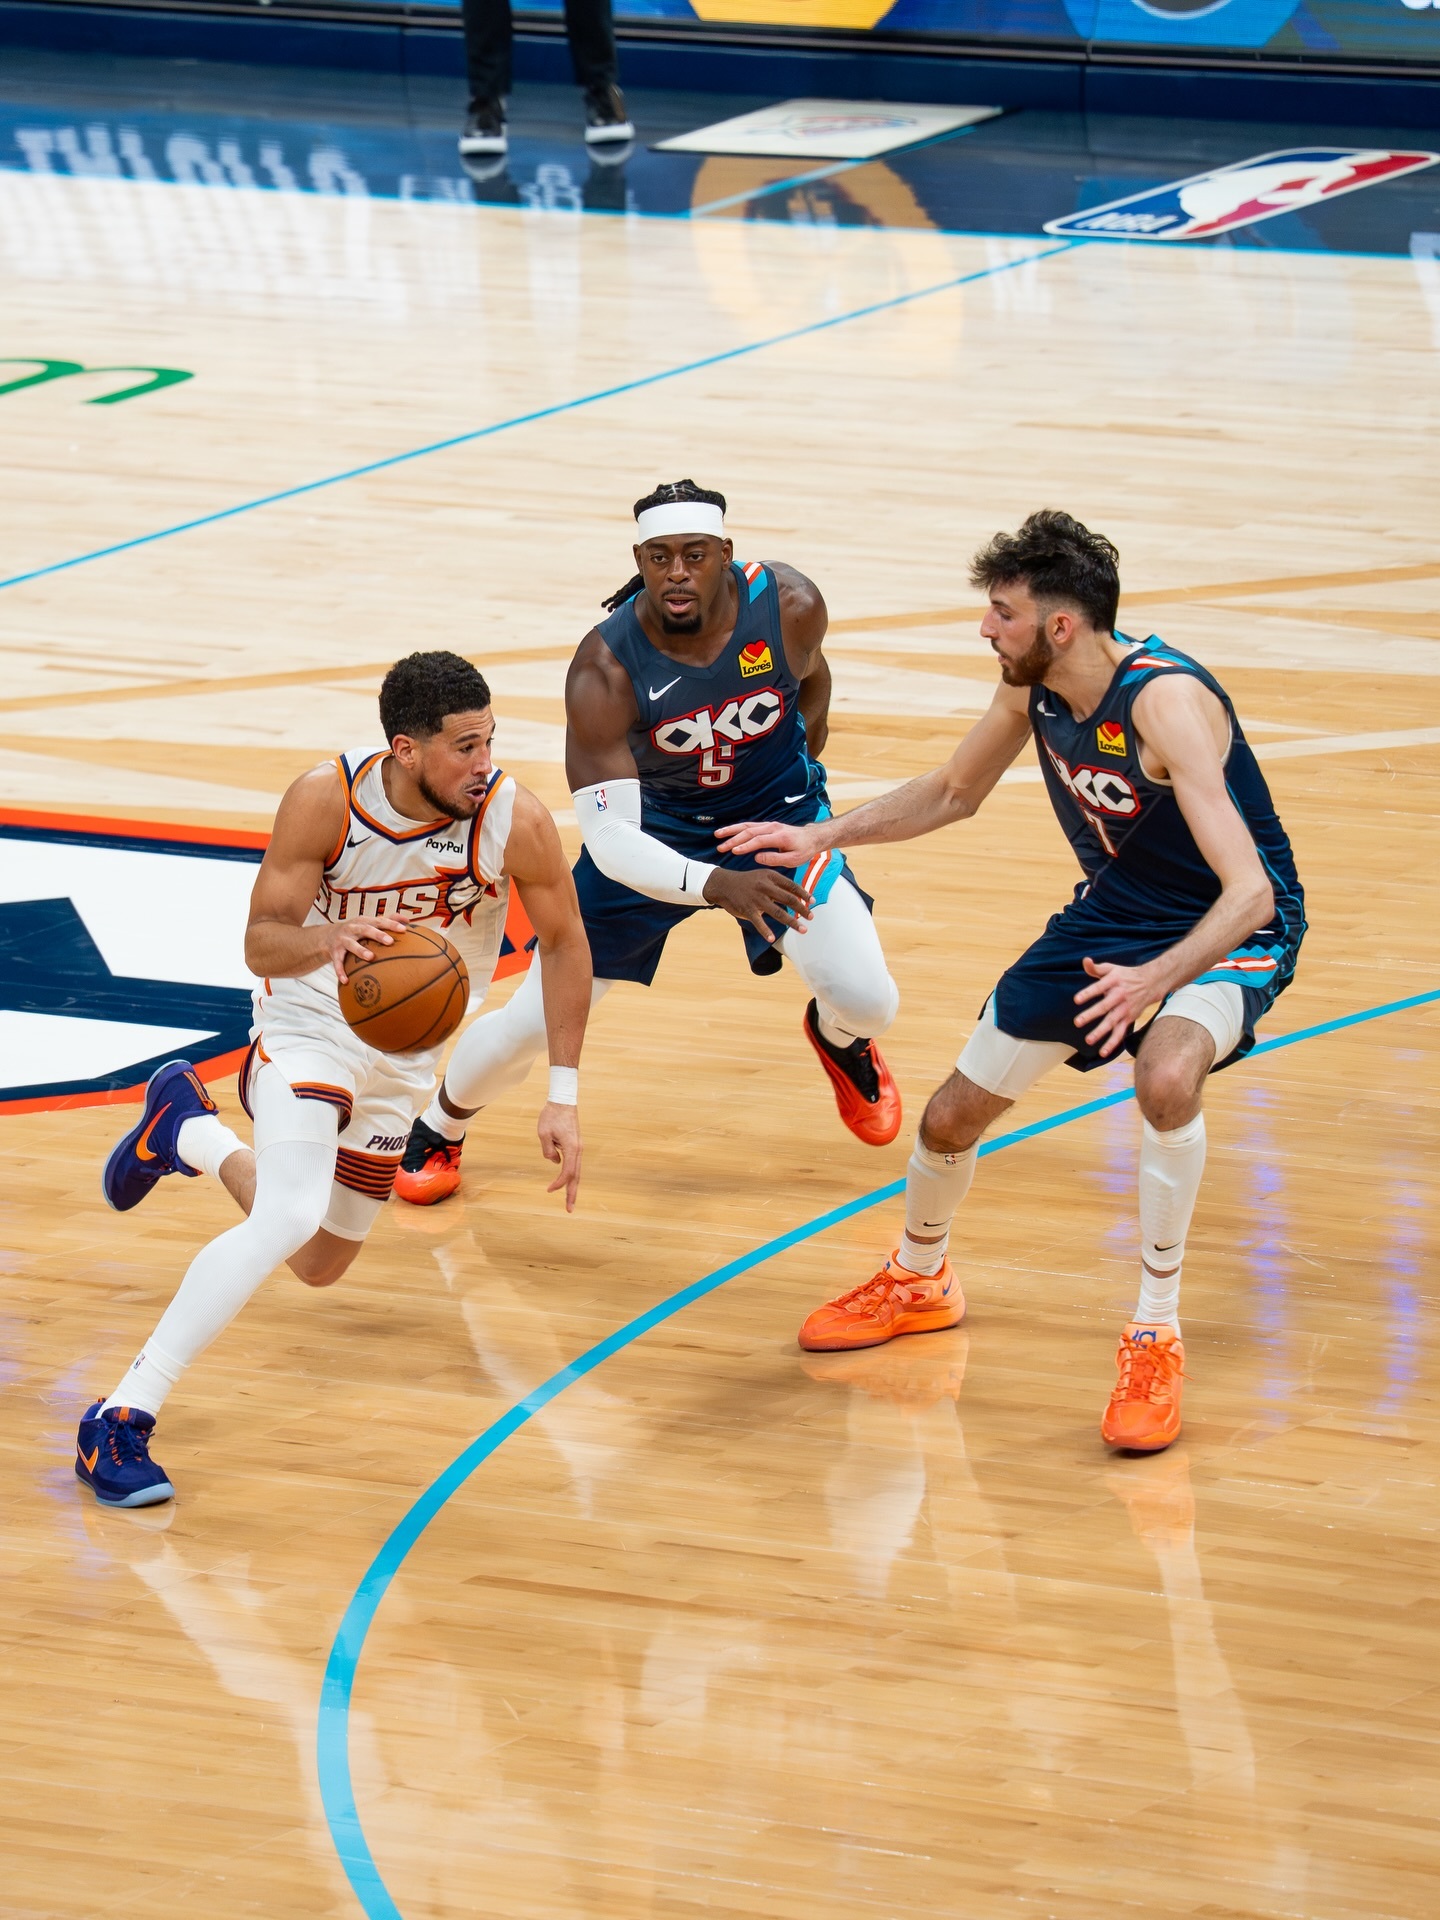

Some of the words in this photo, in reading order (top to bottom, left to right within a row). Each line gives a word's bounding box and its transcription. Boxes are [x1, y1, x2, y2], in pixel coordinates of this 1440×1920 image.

[1073, 212, 1179, 232] NBA
[652, 687, 784, 755] OKC
[698, 744, 735, 788] 5
[425, 838, 464, 854] PayPal
